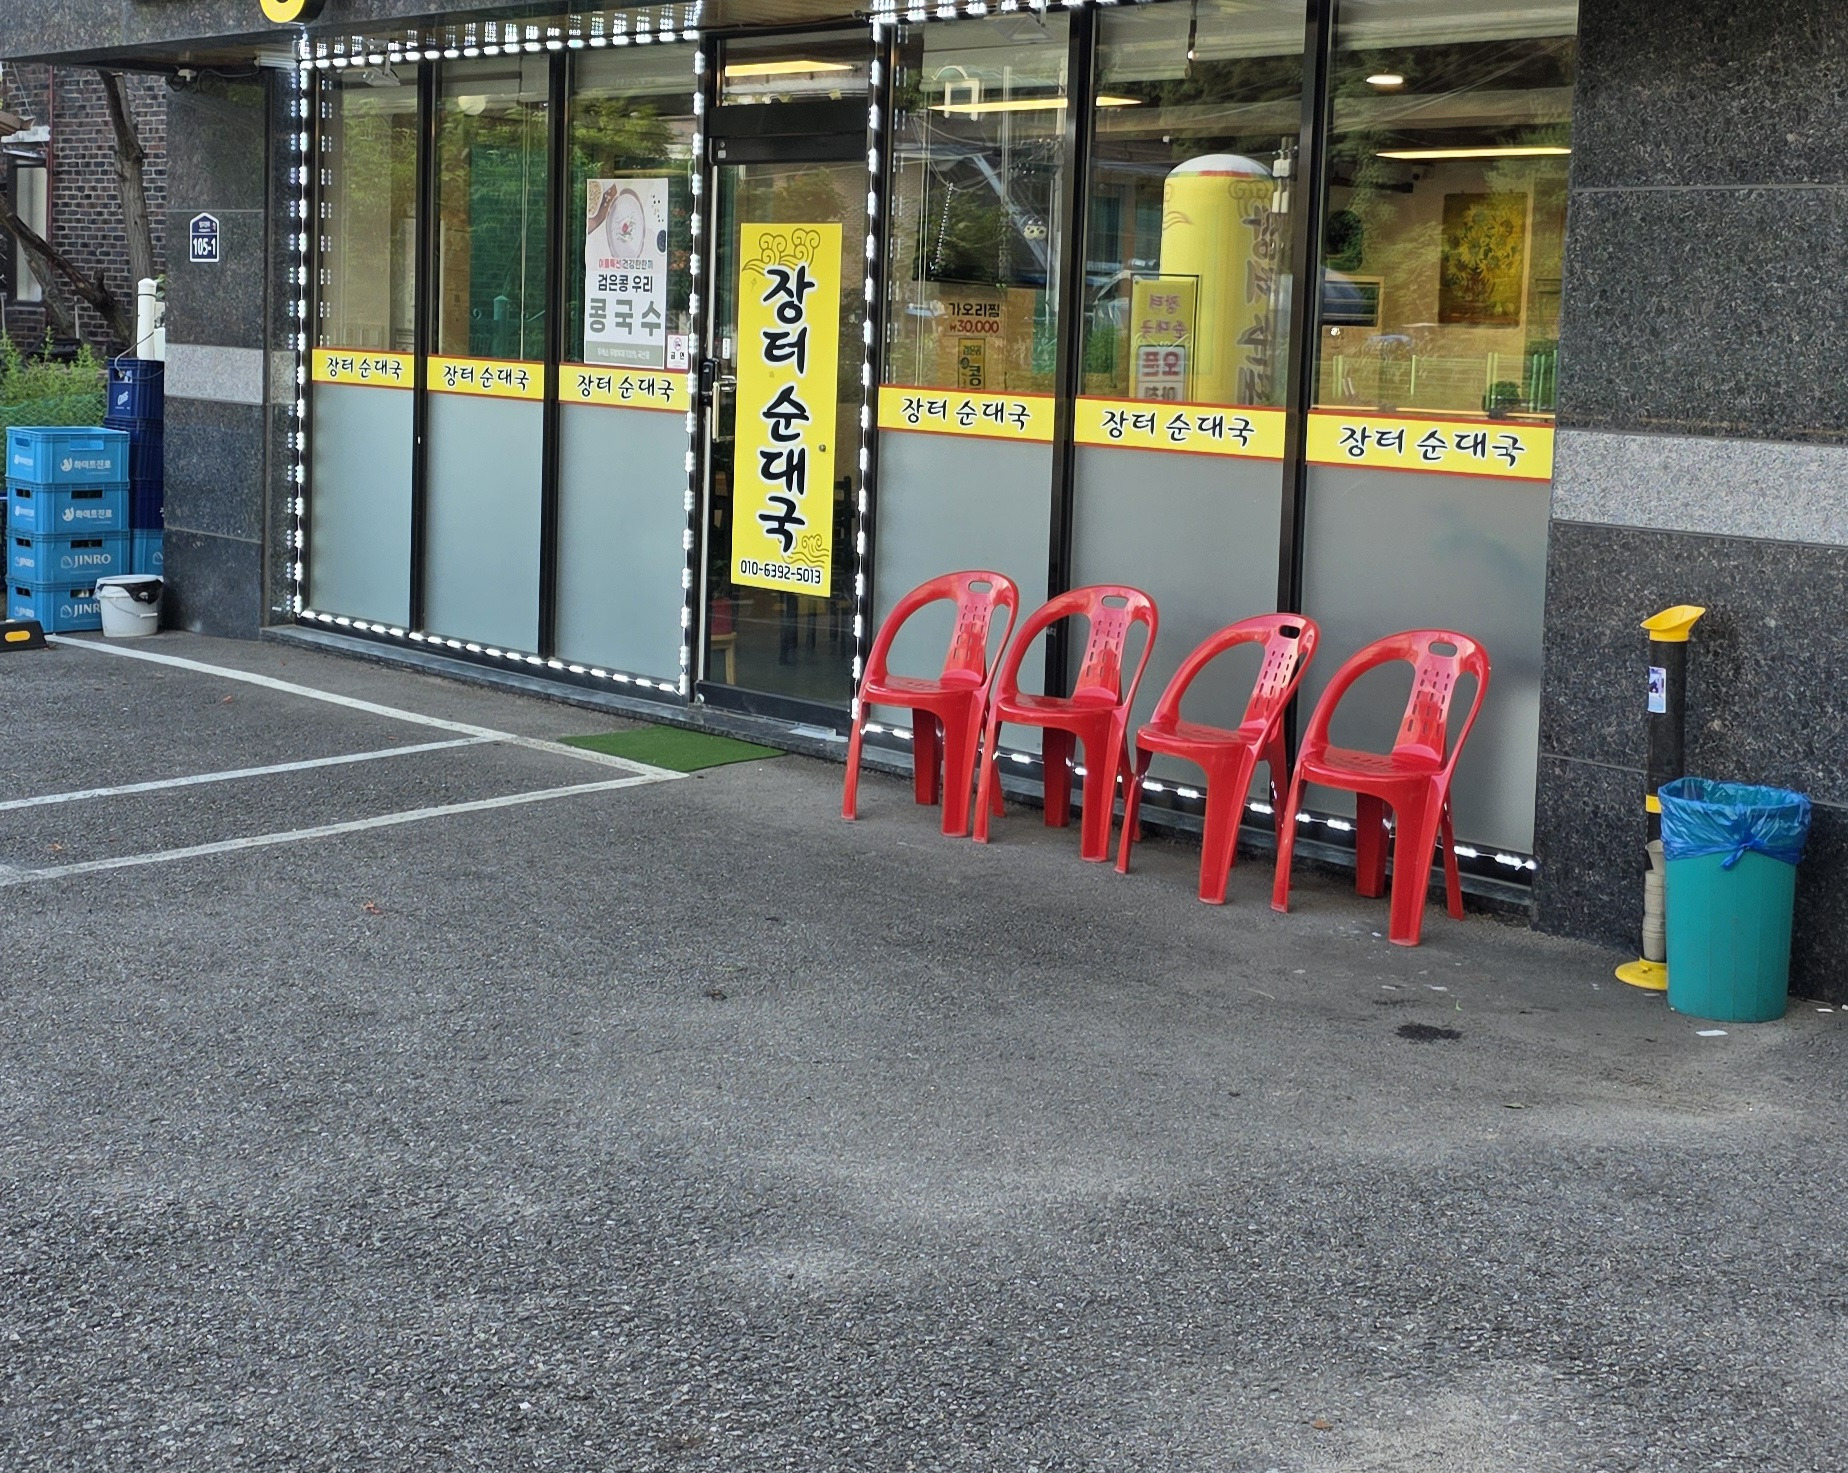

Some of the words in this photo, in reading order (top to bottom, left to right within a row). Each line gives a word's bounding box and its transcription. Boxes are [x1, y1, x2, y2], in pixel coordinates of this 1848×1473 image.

[193, 237, 216, 256] 105-1
[598, 273, 628, 292] 검은콩
[632, 275, 653, 293] 우리
[589, 298, 662, 337] 콩국수
[948, 302, 1000, 318] 가오리찜
[326, 357, 354, 376] 장터
[358, 358, 403, 380] 순대국
[442, 366, 474, 386] 장터
[480, 368, 530, 391] 순대국
[576, 375, 612, 398] 장터
[618, 377, 675, 401] 순대국
[901, 398, 947, 423] 장터
[956, 400, 1031, 430] 순대국
[1101, 411, 1157, 439] 장터
[1165, 414, 1255, 447] 순대국
[1339, 426, 1404, 456] 장터
[1416, 430, 1525, 467] 순대국
[73, 554, 112, 568] JINRO
[740, 559, 821, 584] 010-6392-5013
[73, 603, 101, 617] JINR
